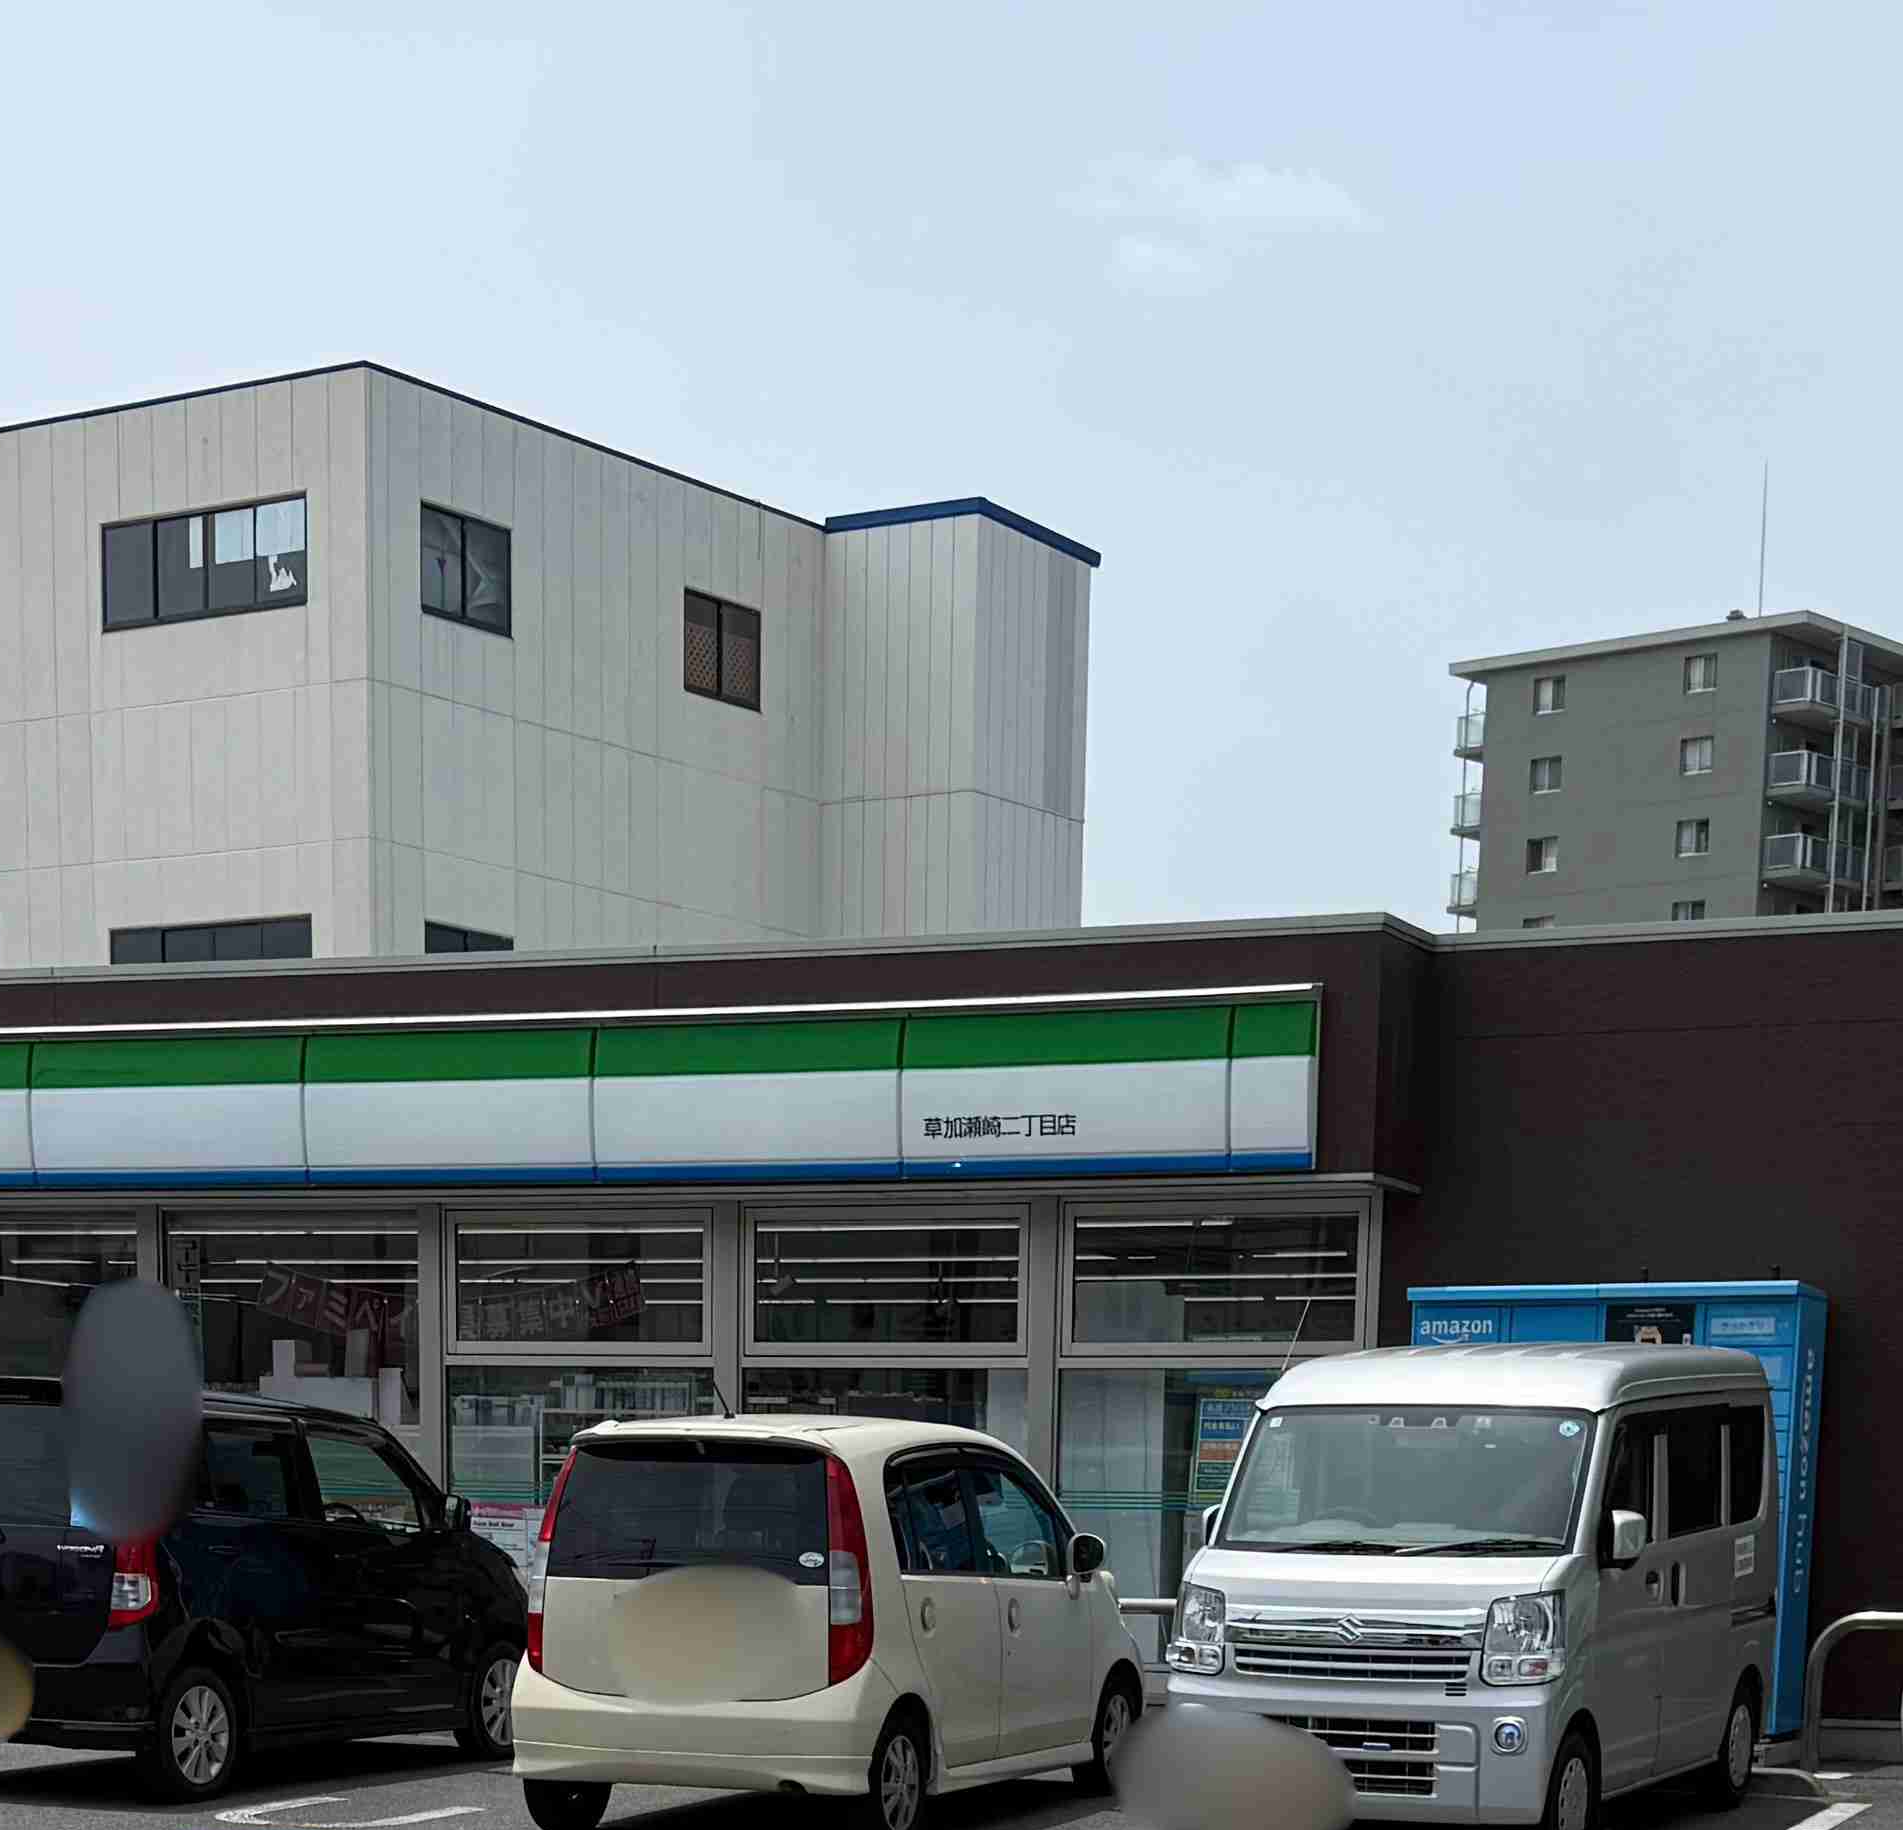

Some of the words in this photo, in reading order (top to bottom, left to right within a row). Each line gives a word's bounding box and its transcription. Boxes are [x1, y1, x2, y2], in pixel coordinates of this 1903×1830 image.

[923, 1113, 1077, 1141] 草加瀬崎二丁目店
[1419, 1316, 1494, 1338] amazon
